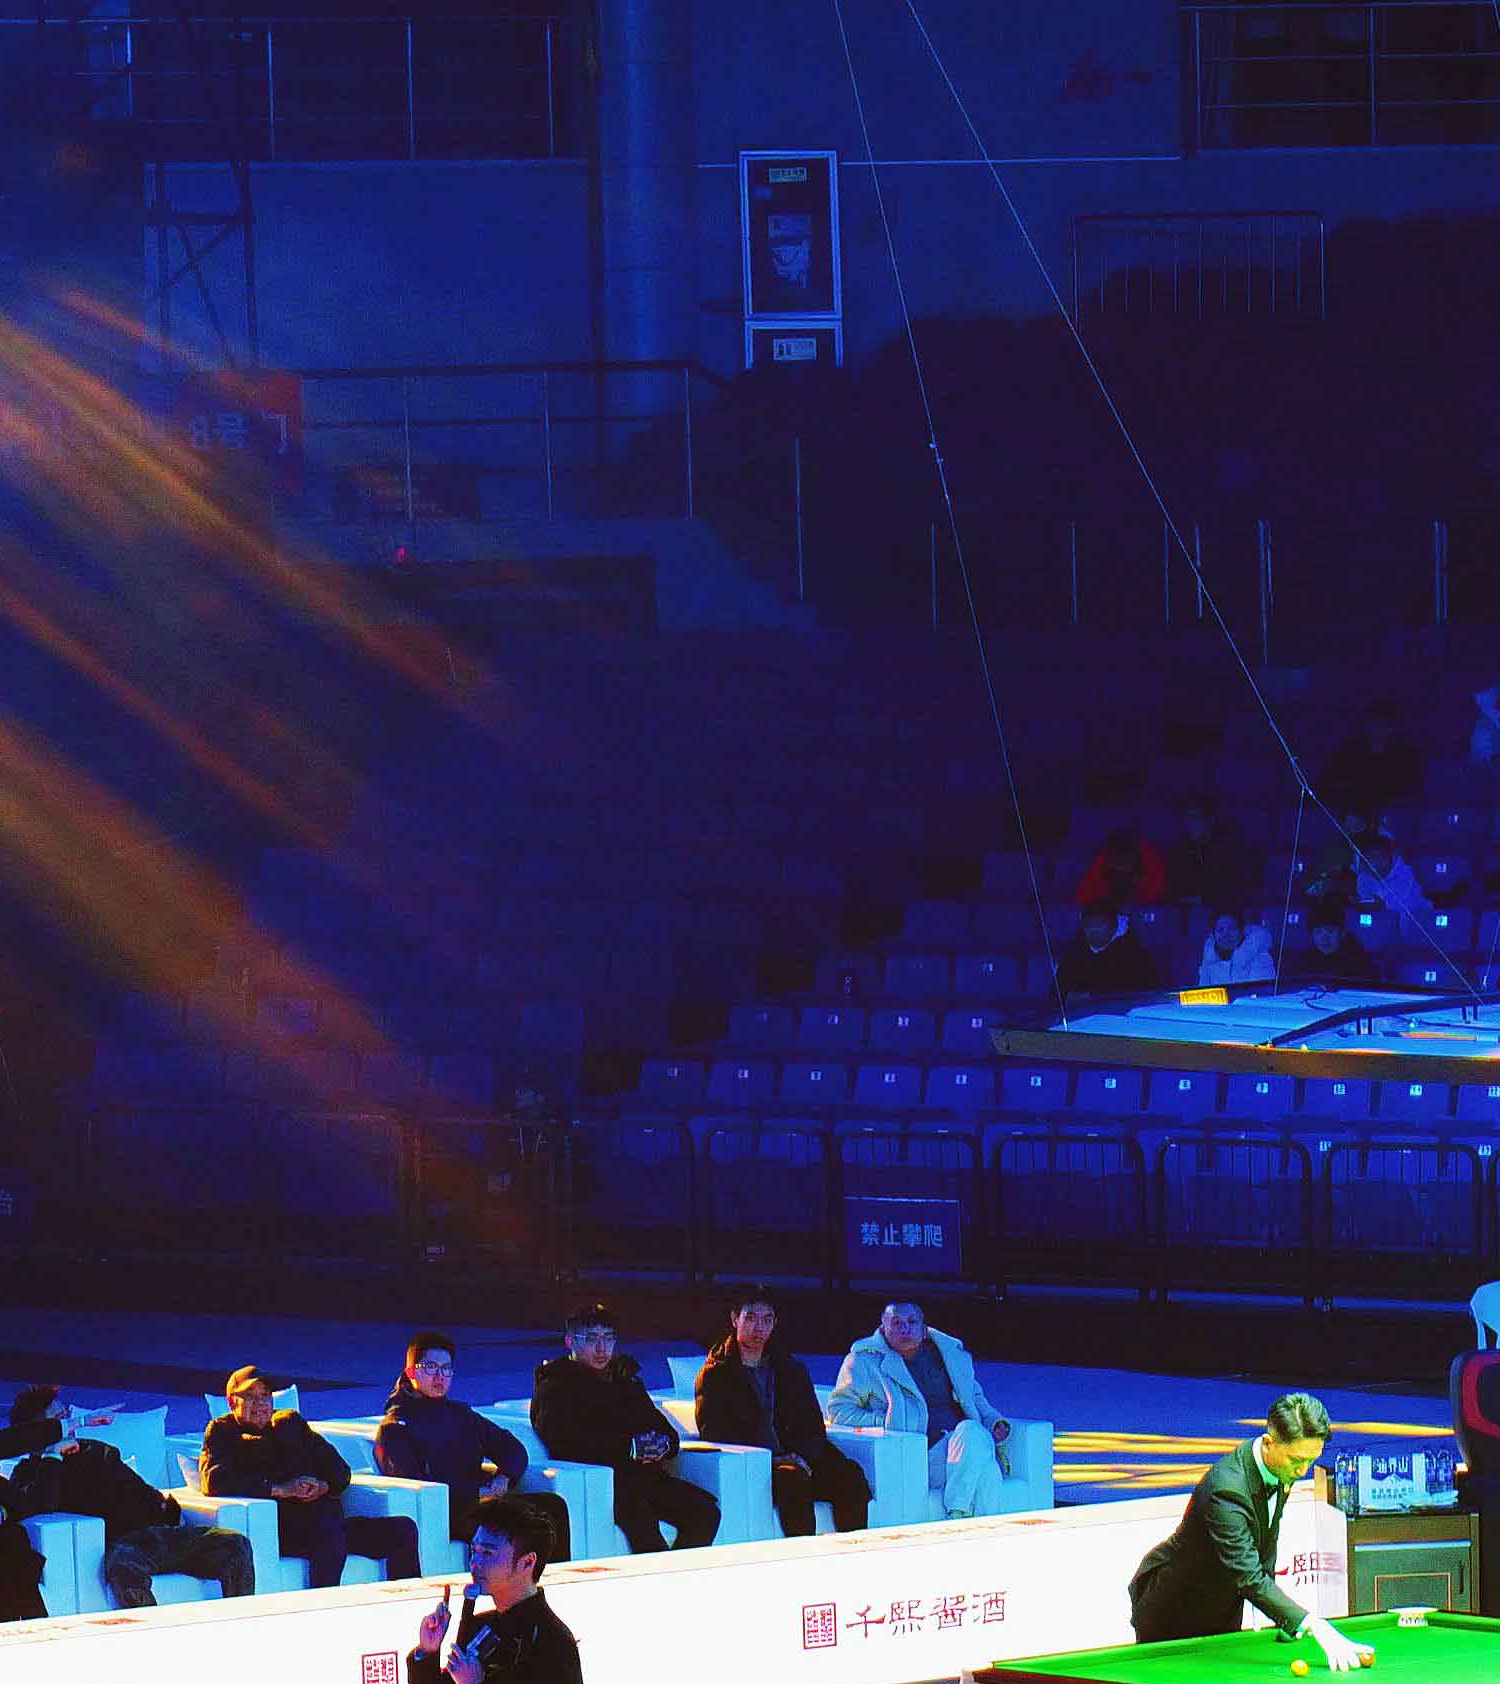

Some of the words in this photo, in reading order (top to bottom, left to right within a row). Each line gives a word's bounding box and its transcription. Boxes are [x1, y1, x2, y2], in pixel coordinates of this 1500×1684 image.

[860, 1222, 943, 1248] 禁止攀爬
[845, 1589, 1008, 1640] 千熙酱酒
